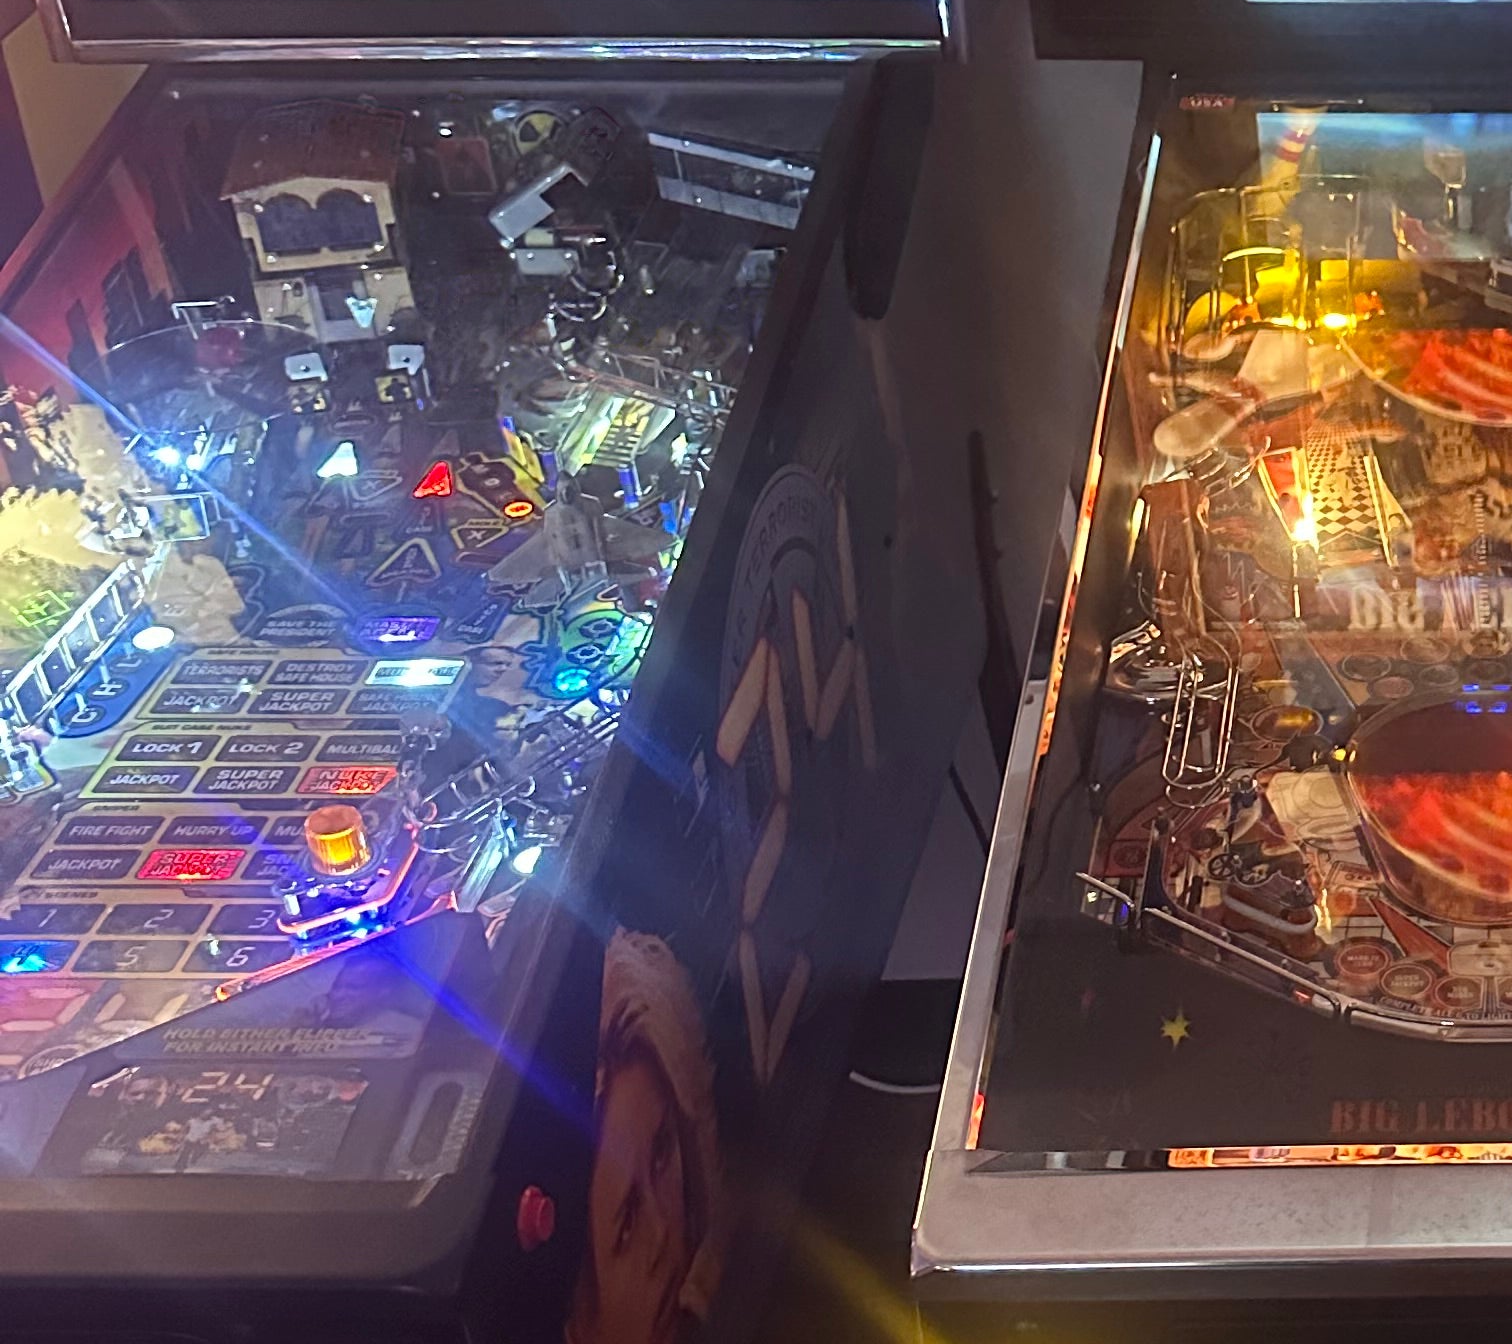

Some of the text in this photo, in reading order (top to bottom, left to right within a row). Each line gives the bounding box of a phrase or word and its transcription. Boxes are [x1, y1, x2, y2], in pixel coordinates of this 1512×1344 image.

[269, 691, 335, 702] SUPER
[259, 701, 333, 713] JACKPOT
[131, 741, 203, 755] LOCK 1
[227, 741, 304, 755] LOCK 2
[325, 743, 400, 756] MULTIBAL
[109, 773, 181, 786] JACKPOT
[216, 769, 285, 780] SUPER
[207, 780, 279, 791] JACKPOT
[68, 825, 153, 837] FIRE FIGHT
[173, 825, 255, 837] HURRY UP
[47, 857, 122, 871] JACKPOT
[159, 852, 230, 865] SUPER
[143, 908, 175, 929] 2
[247, 908, 277, 929] 3
[115, 945, 147, 968] 5
[225, 945, 257, 968] 6
[163, 1027, 219, 1040] HOLD
